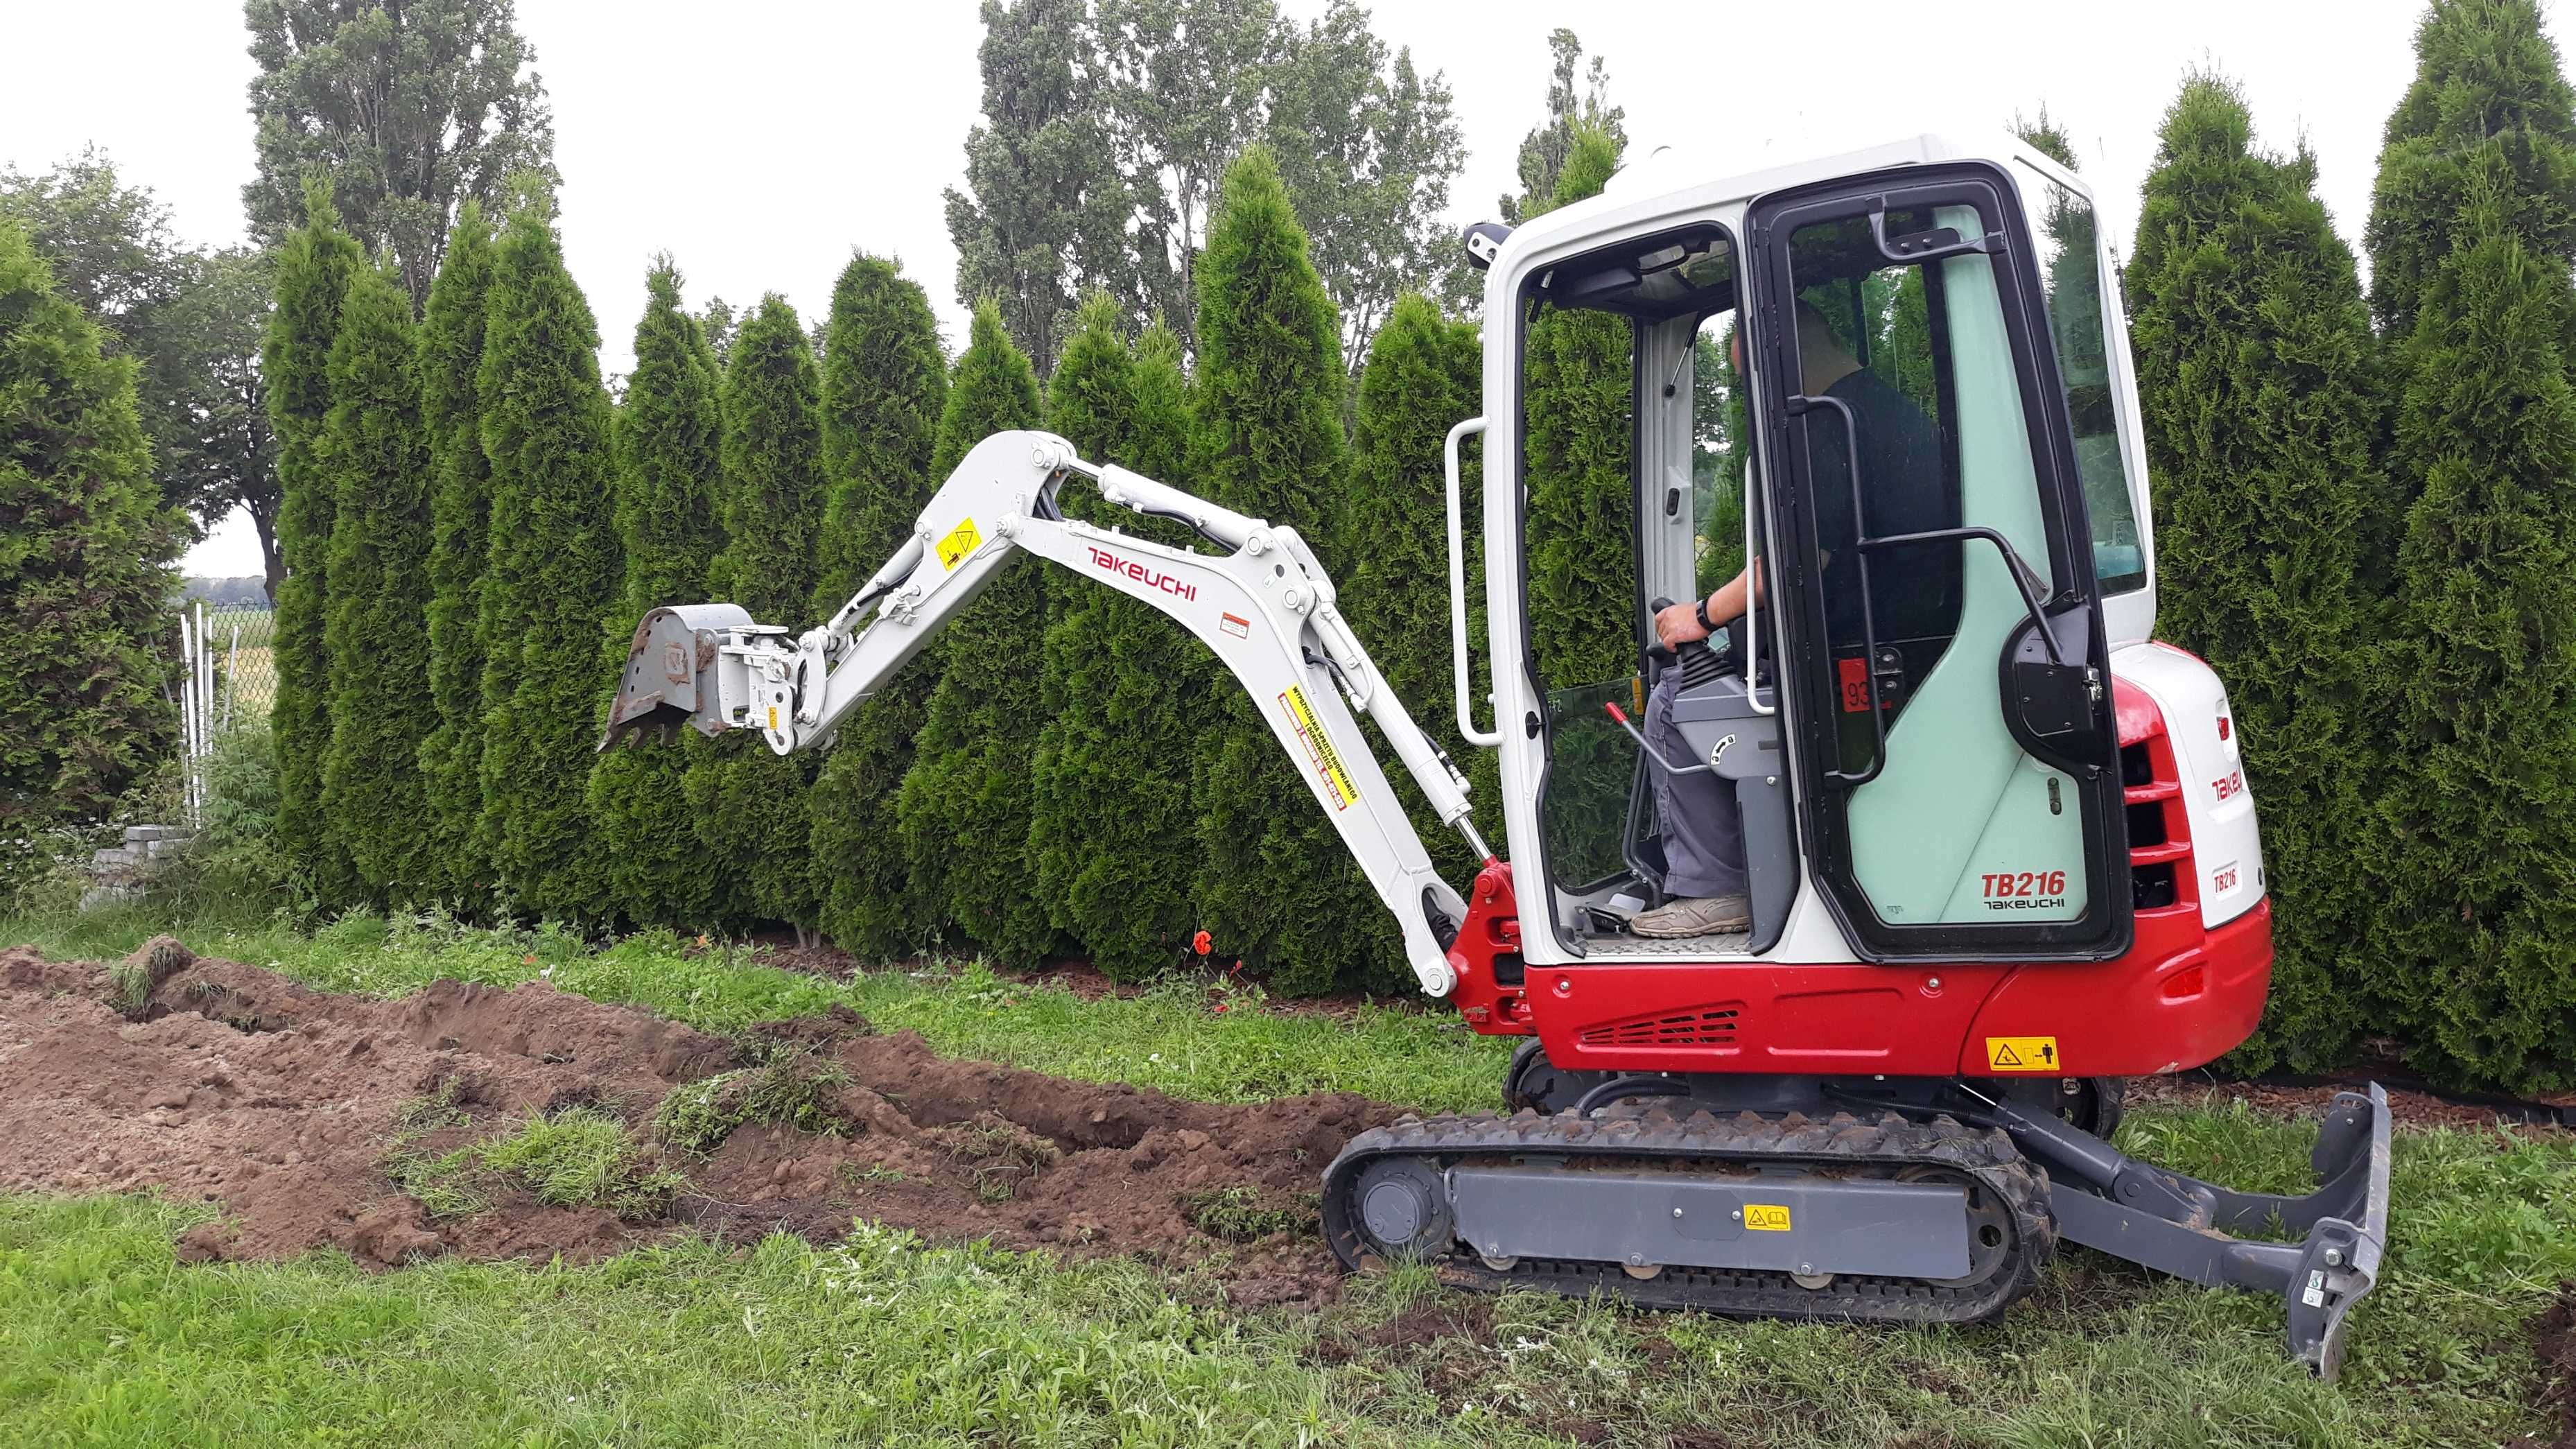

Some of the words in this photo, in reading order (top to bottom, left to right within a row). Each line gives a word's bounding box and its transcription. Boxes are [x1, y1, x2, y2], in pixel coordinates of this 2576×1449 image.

[1088, 546, 1197, 602] TAKEUCHI
[1307, 727, 1333, 770] OGRODNICZEGO
[1331, 756, 1357, 799] BUDOWLANEGO
[1981, 870, 2066, 898] TB216
[2213, 868, 2236, 894] TB216
[1984, 899, 2065, 910] TAKEUCHI
